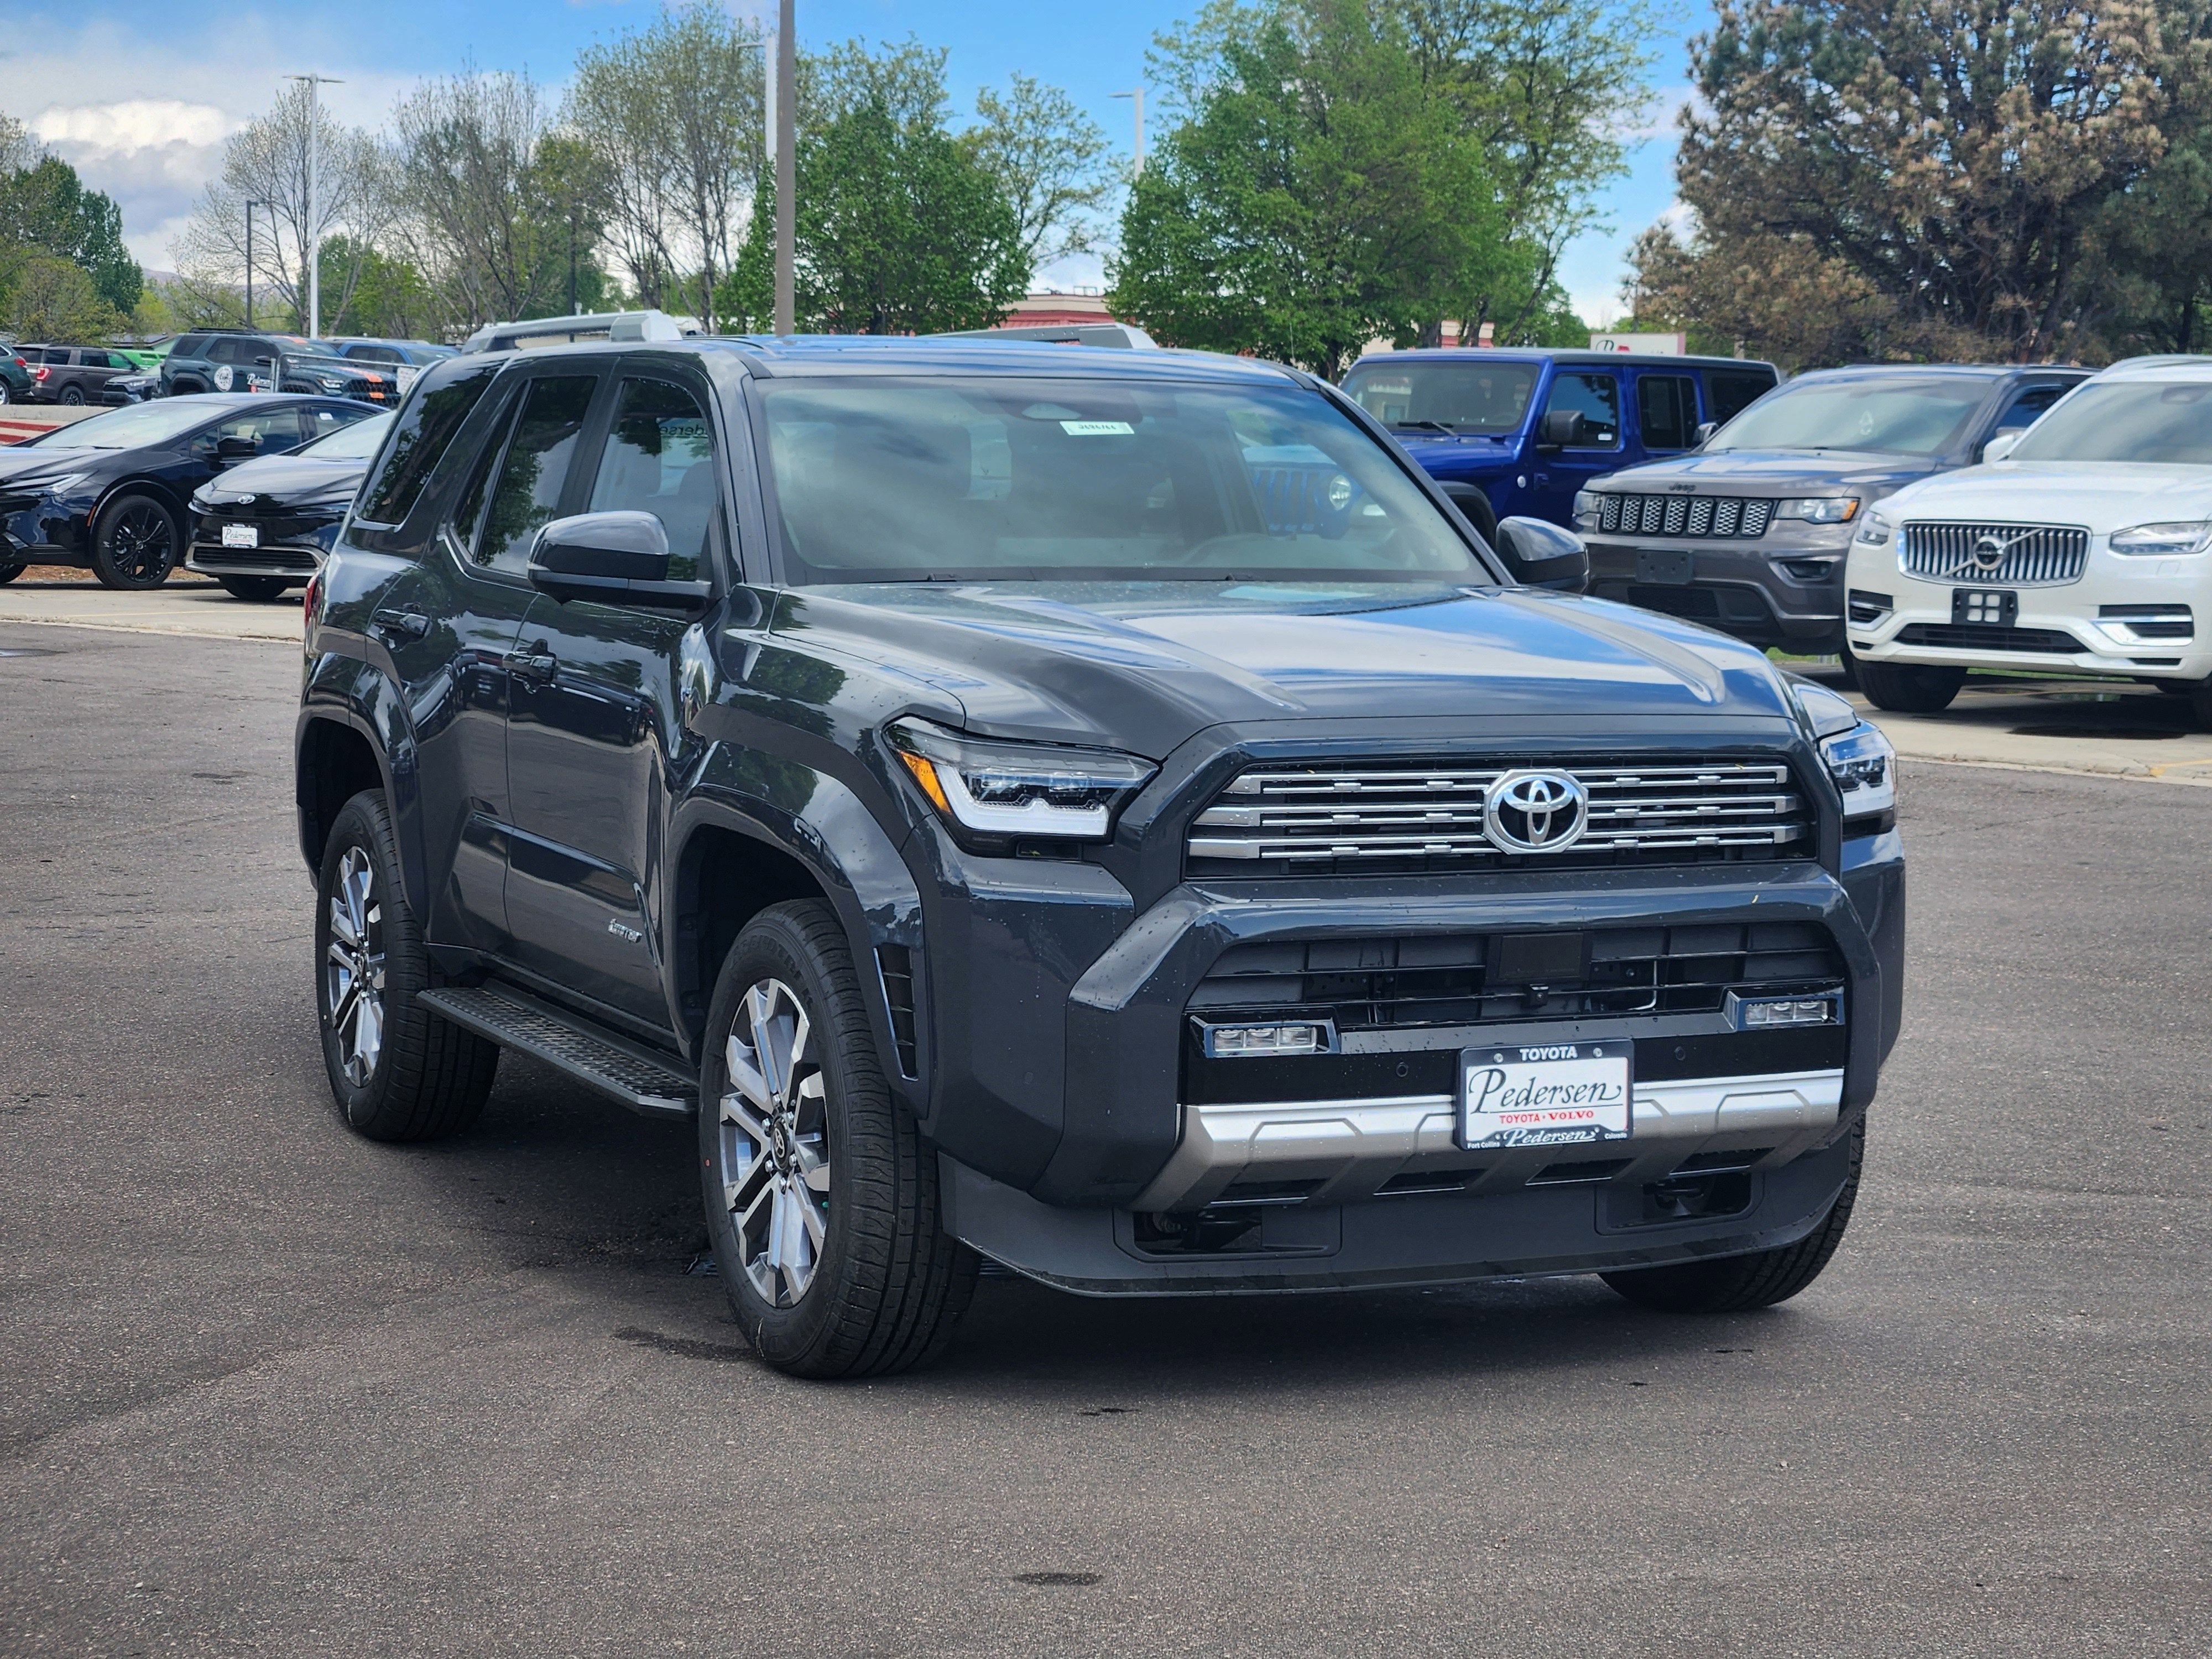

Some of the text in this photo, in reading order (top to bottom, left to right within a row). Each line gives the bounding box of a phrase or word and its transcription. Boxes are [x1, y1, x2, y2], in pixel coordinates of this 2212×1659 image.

[1668, 482, 1697, 493] Jeep
[1519, 1045, 1578, 1062] TOYOTA
[1468, 1068, 1622, 1115] Pedersen
[1499, 1110, 1594, 1124] TOYOTA VOLVO
[1504, 1128, 1597, 1147] Pedersen
